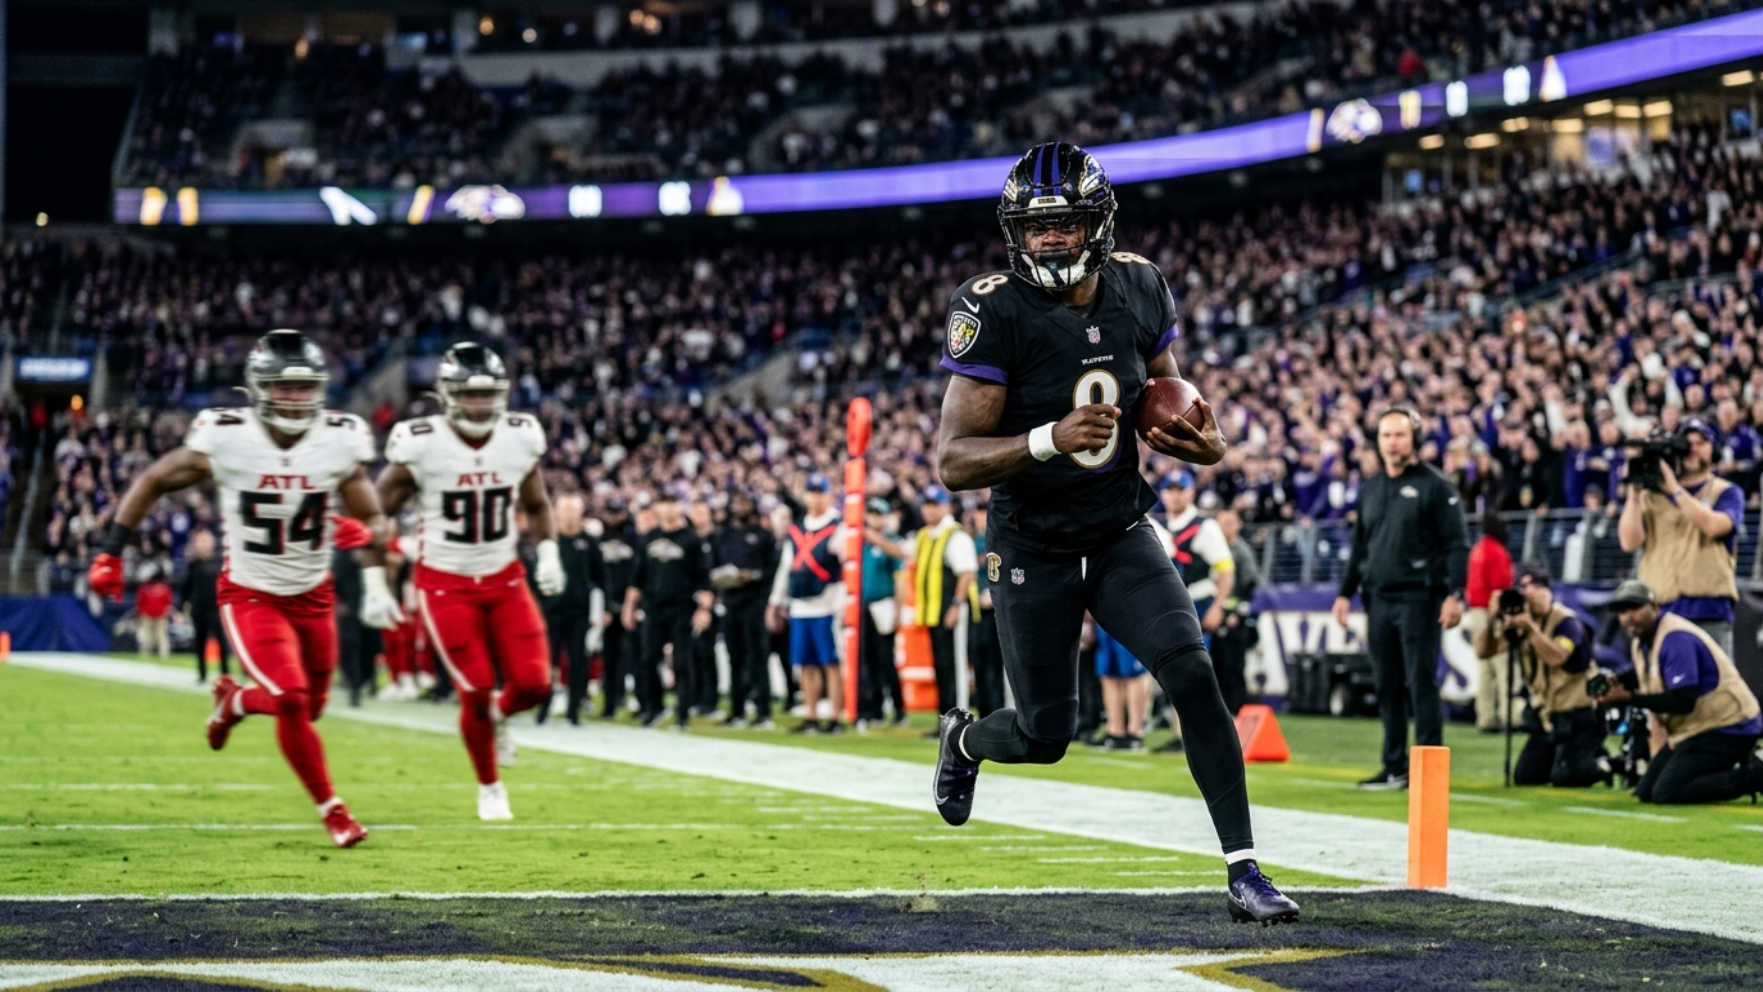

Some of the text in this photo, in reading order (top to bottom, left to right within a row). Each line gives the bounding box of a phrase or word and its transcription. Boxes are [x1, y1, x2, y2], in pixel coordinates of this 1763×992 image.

[971, 274, 1009, 296] 8
[1069, 368, 1121, 470] 8
[258, 474, 316, 490] ATL
[457, 471, 503, 487] ATL
[240, 490, 328, 555] 54
[441, 485, 514, 545] 90
